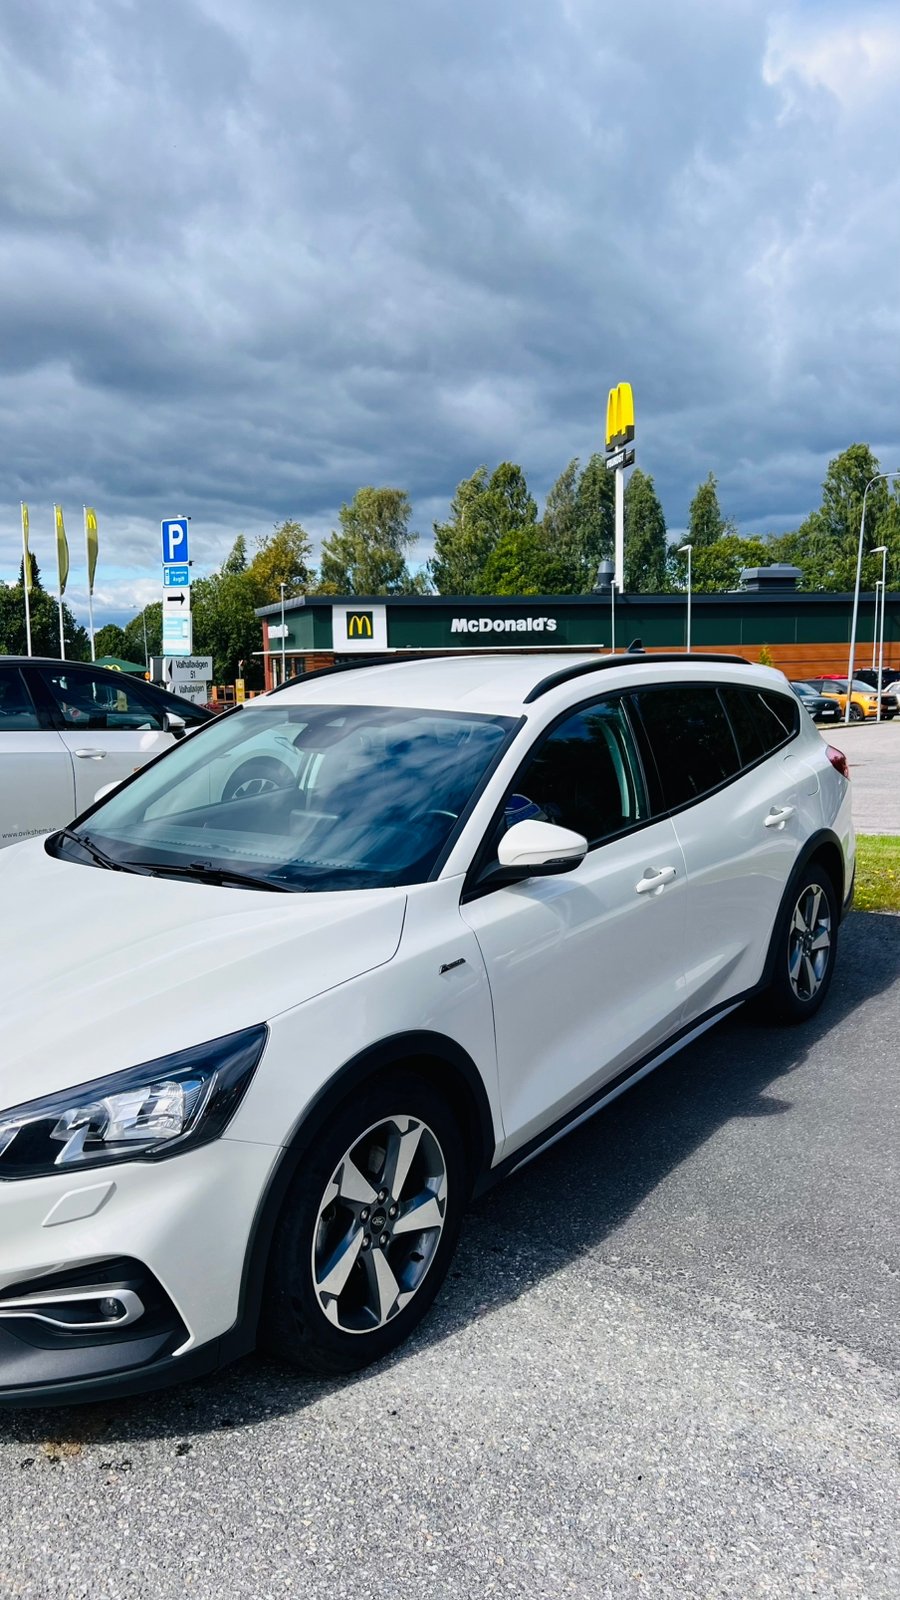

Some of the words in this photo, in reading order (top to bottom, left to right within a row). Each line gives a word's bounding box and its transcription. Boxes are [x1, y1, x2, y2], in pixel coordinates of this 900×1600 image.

[168, 523, 184, 560] P
[451, 617, 557, 633] McDonald's
[190, 670, 196, 679] 51
